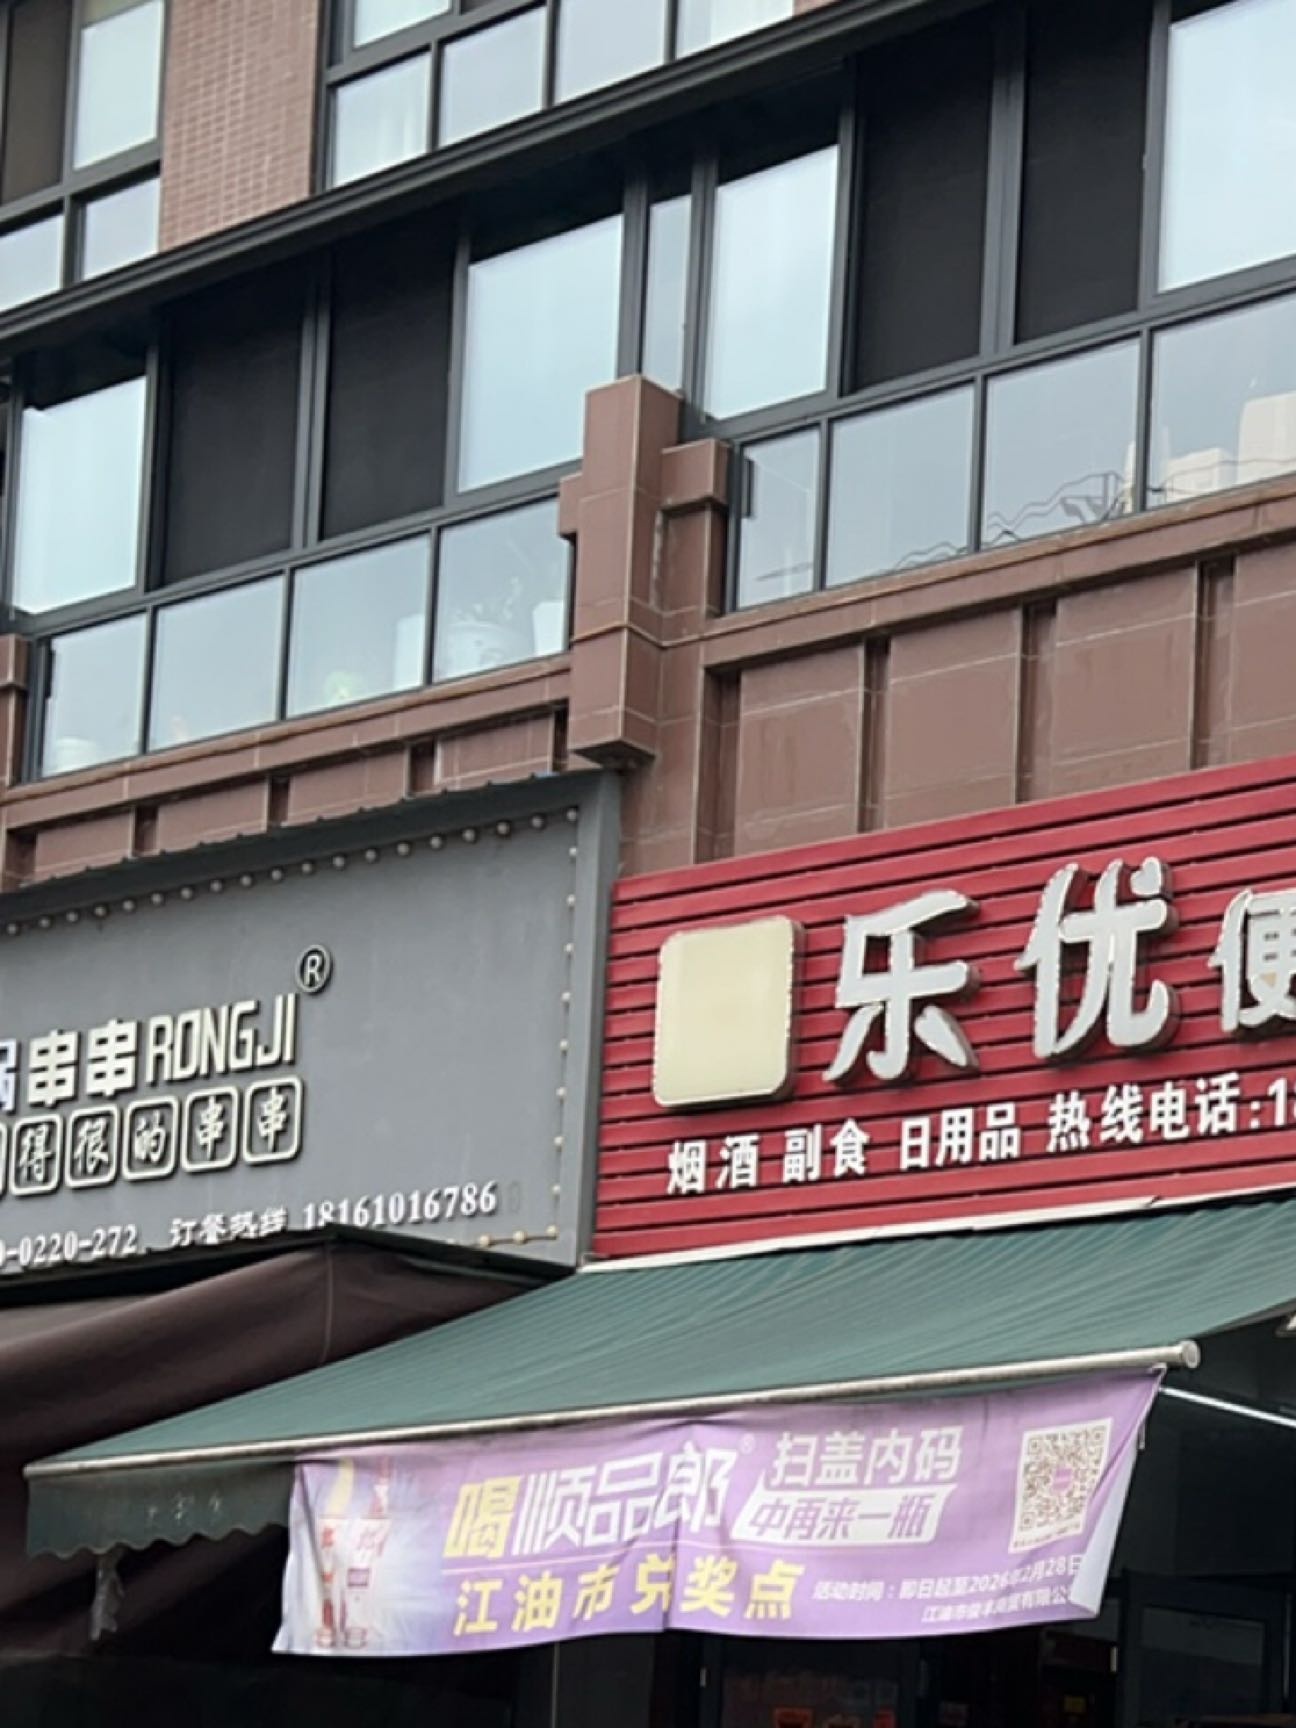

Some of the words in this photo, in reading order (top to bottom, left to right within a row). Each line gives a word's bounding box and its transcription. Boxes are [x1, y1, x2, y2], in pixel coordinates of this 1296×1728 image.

[145, 992, 297, 1084] RONGJI
[666, 1132, 761, 1195] 烟酒
[781, 1118, 871, 1183] 副食
[899, 1102, 1021, 1172] 日用品
[442, 1440, 739, 1559] 喝顺品郎
[772, 1425, 963, 1488] 扫盖内码
[748, 1490, 938, 1541] 中再来一瓶
[452, 1552, 806, 1637] 江油市兑奖点
